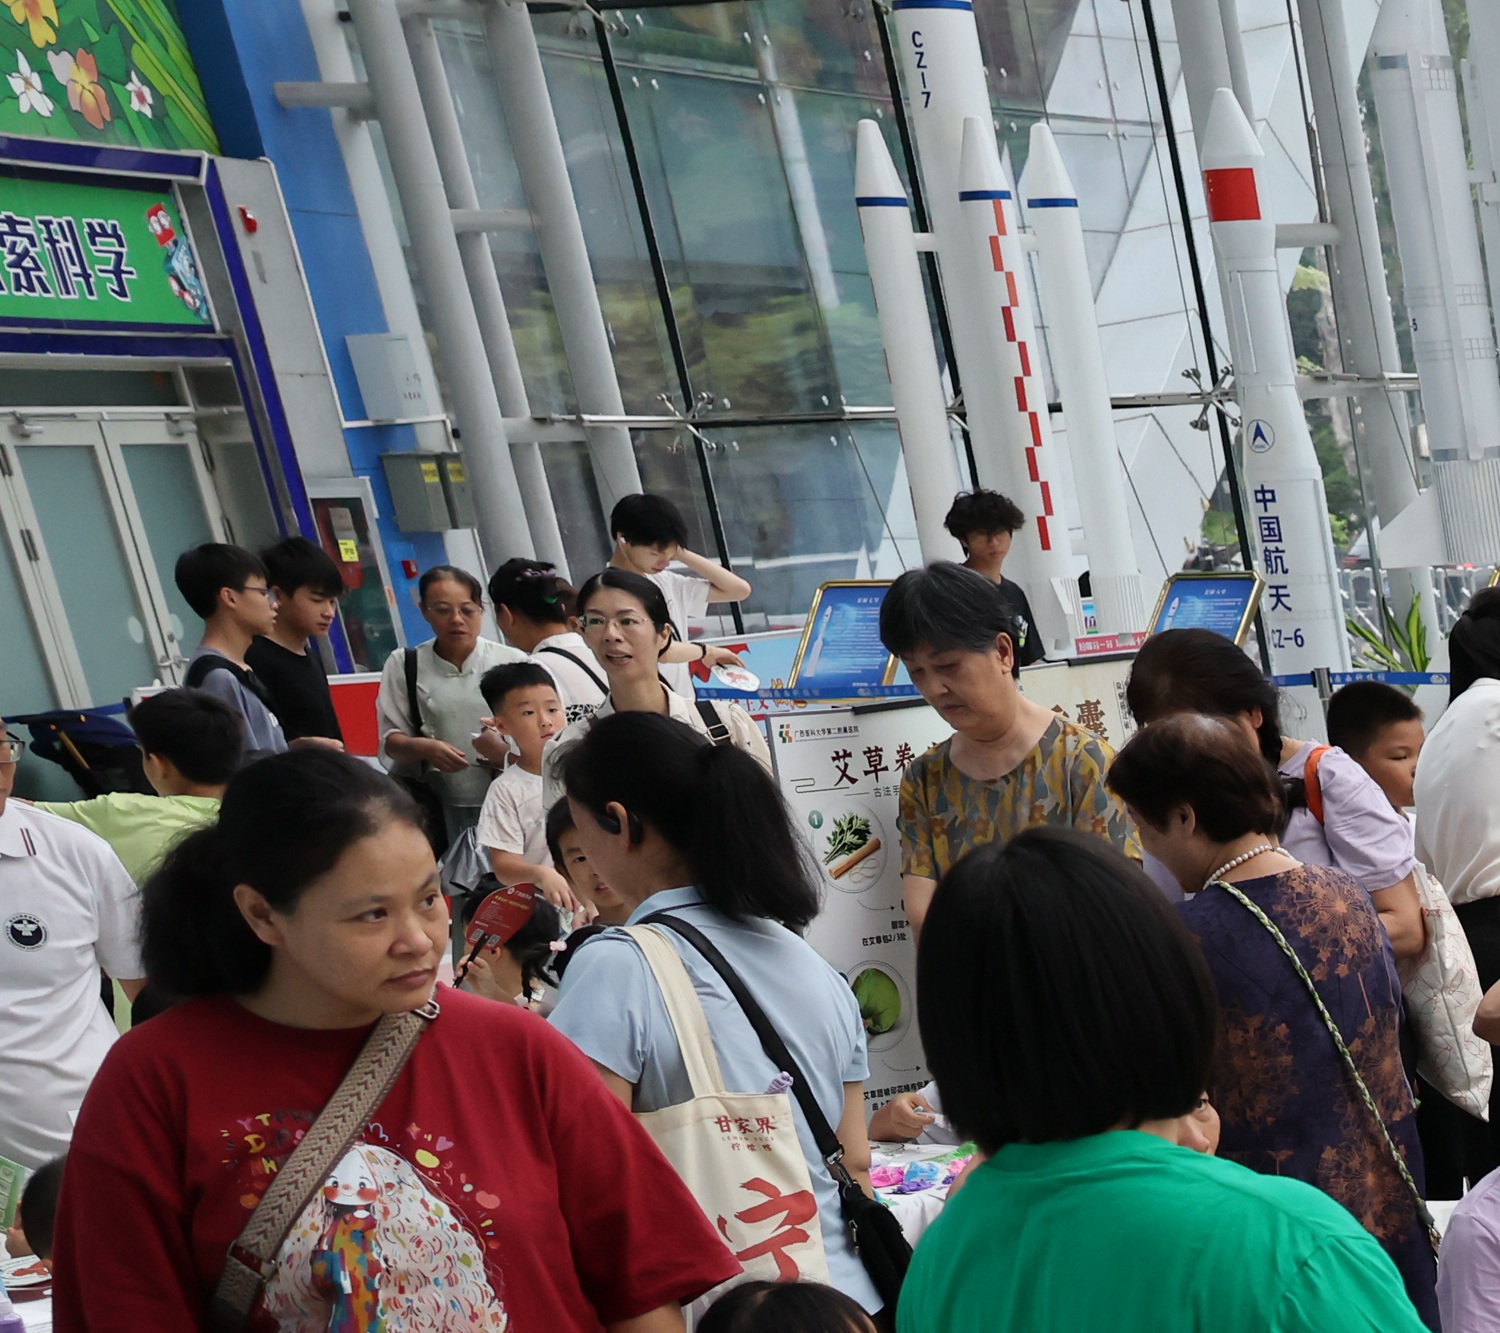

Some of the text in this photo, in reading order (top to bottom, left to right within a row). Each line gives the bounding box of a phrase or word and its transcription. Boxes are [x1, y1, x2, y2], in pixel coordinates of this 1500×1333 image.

[0, 211, 138, 302] 索科学
[1254, 484, 1292, 612] 中国航天
[1271, 628, 1305, 649] CZ-6
[831, 742, 938, 787] 艾草养
[714, 1115, 777, 1134] 甘家界
